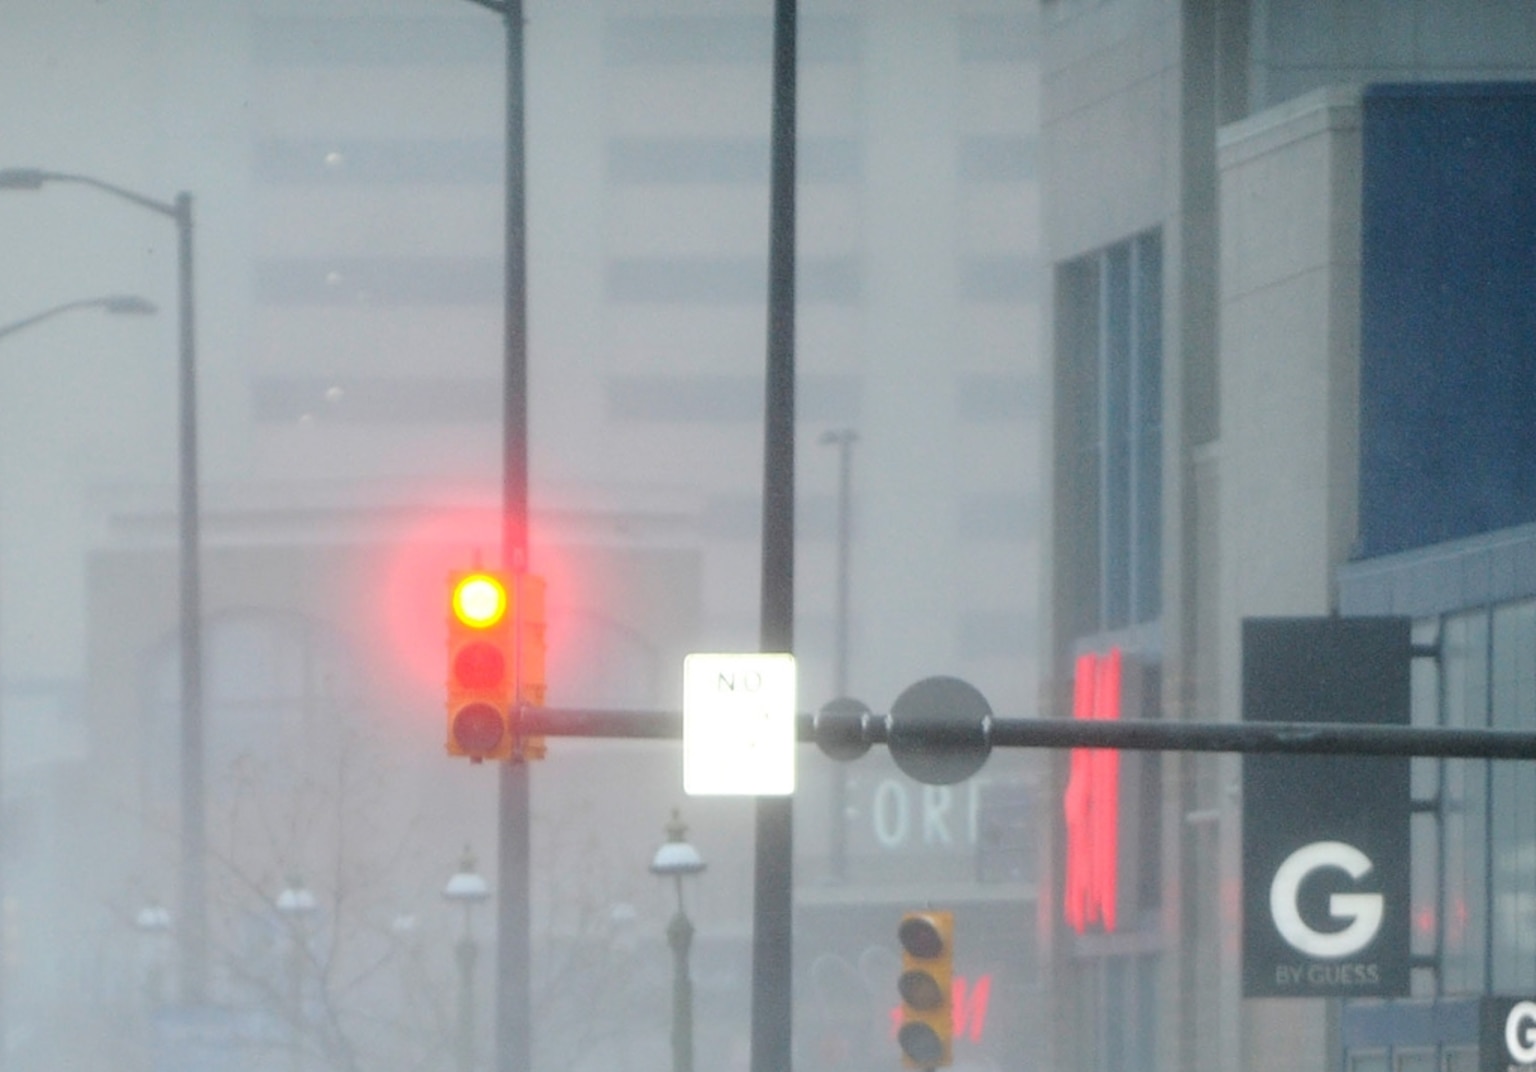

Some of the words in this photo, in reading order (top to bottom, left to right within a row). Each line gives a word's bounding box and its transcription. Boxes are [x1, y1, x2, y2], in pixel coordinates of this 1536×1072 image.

[716, 670, 763, 693] NO
[1269, 840, 1385, 958] G
[1275, 964, 1303, 985] BY
[1306, 963, 1380, 985] GUESS
